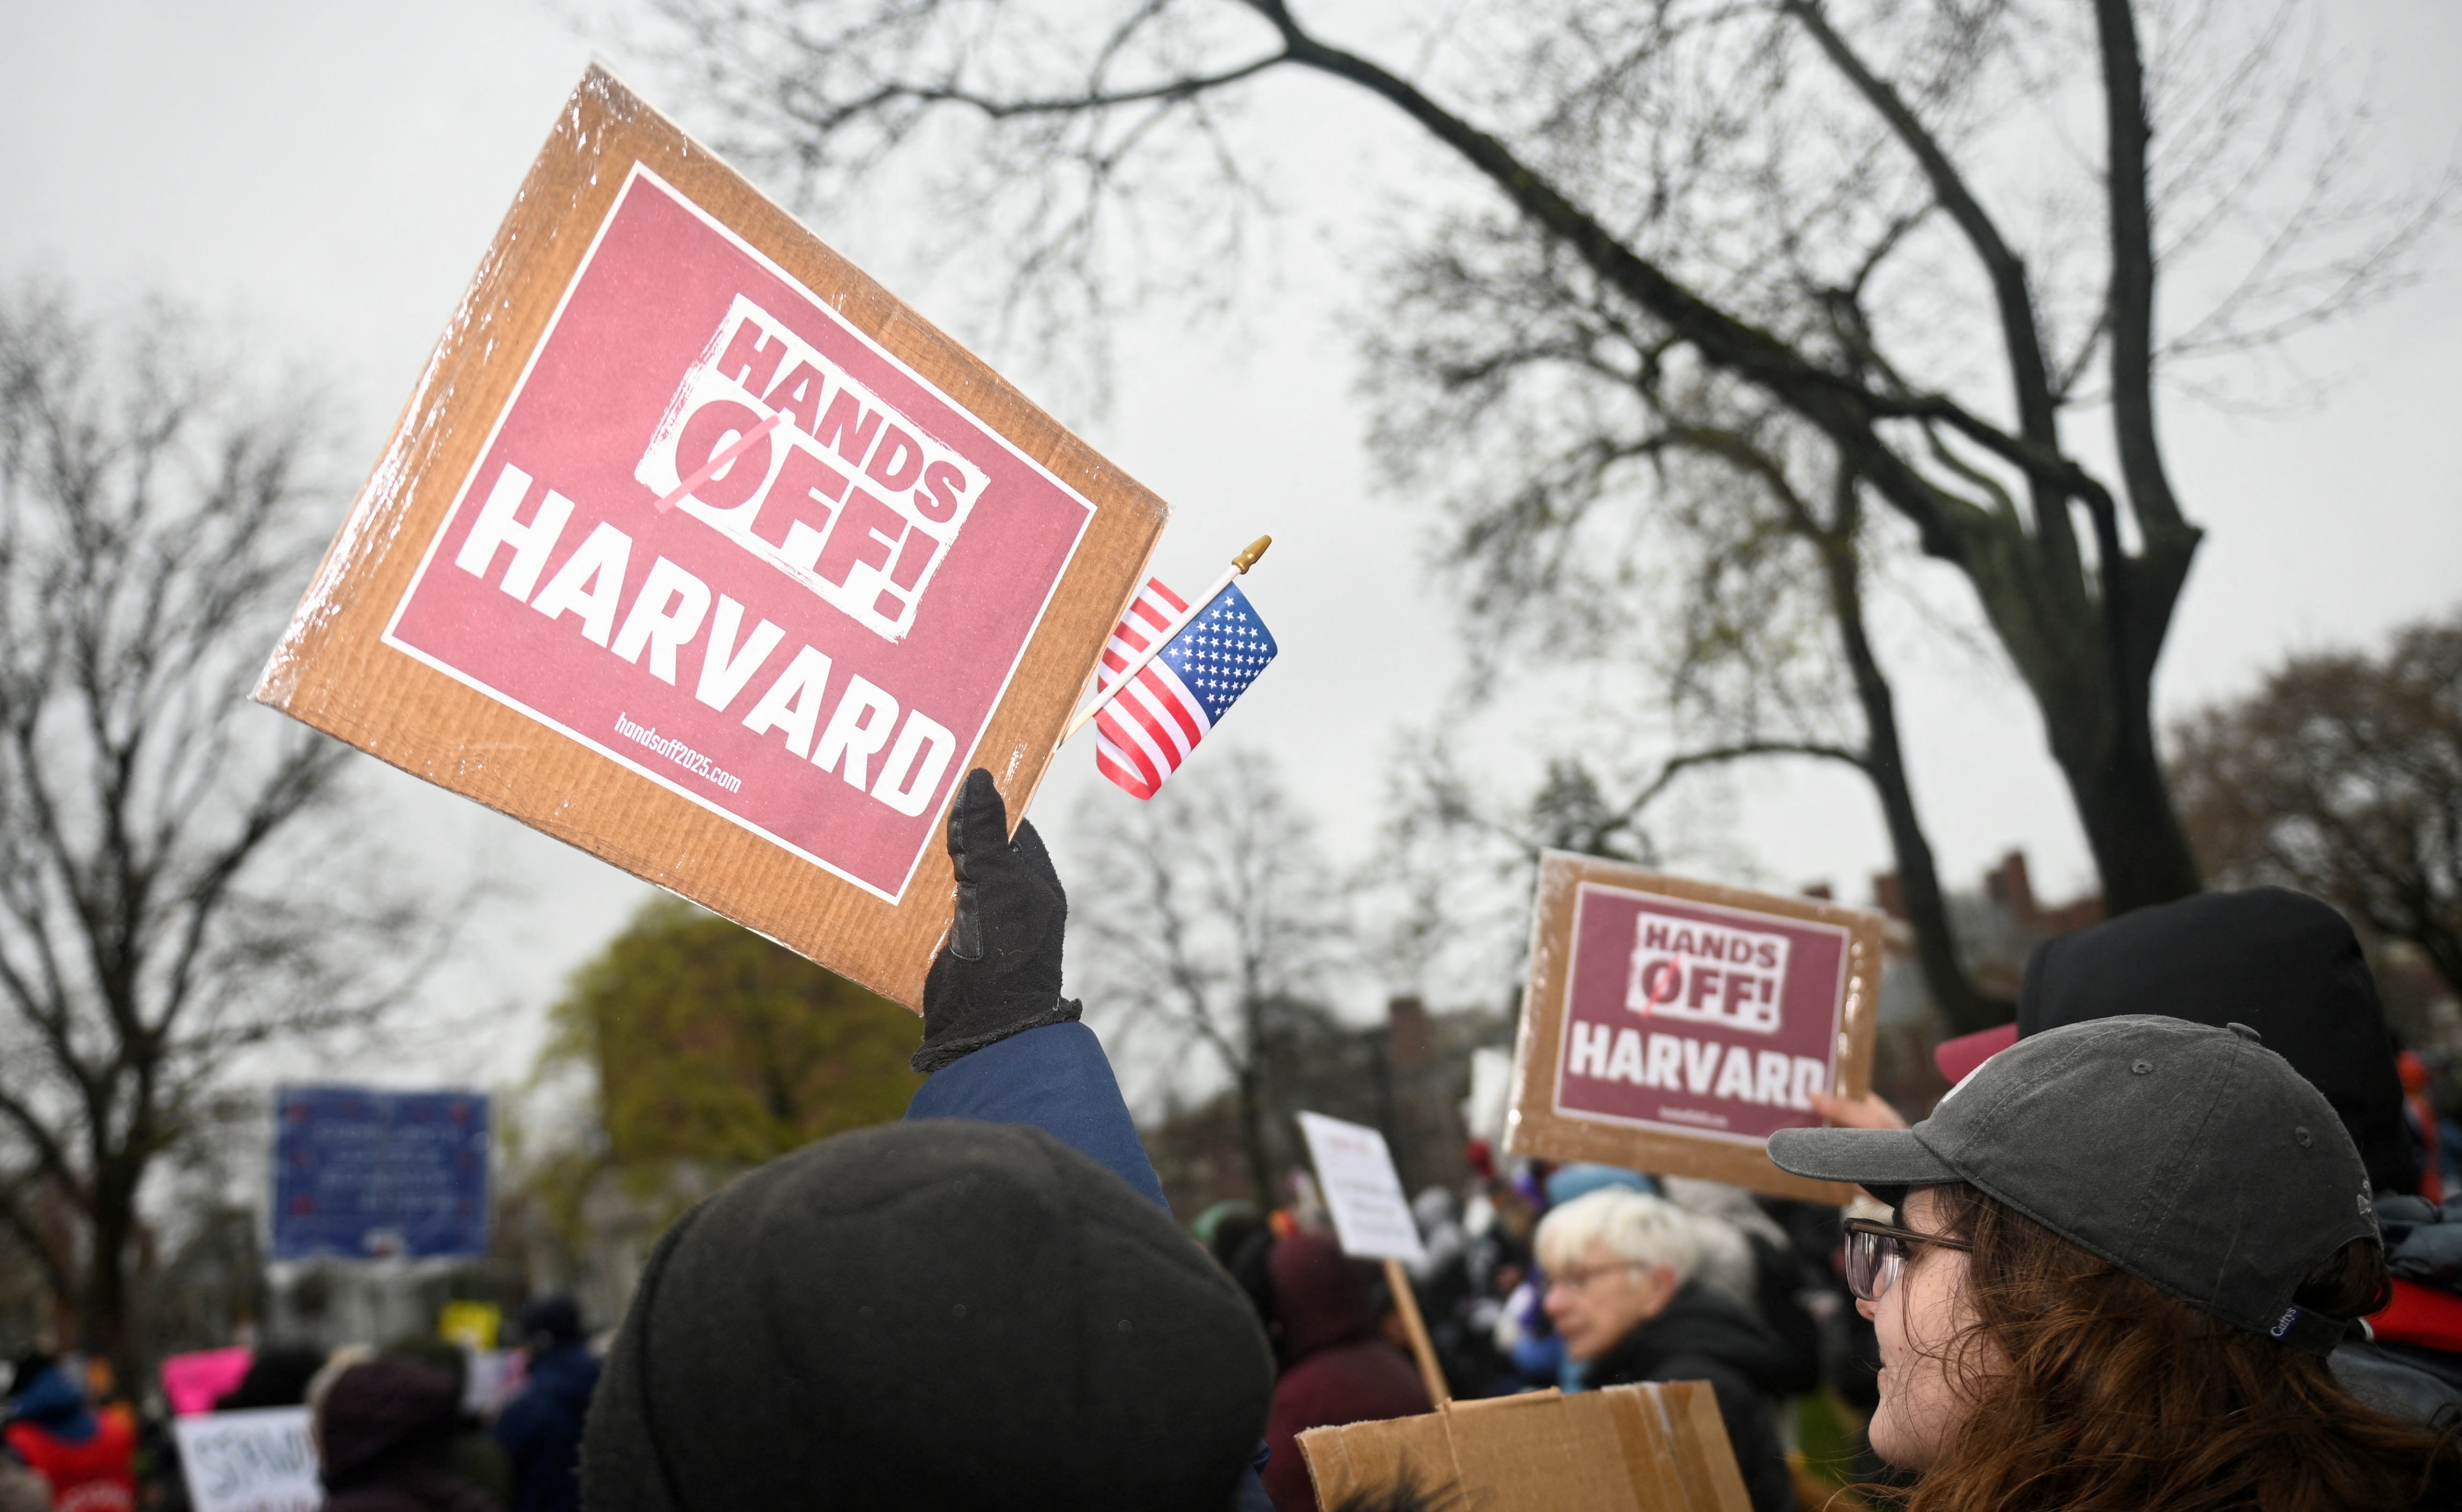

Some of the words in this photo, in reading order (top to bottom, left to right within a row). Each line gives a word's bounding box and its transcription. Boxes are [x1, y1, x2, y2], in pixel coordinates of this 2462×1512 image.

[717, 317, 966, 523] HANDS
[675, 400, 940, 623] OFF!
[455, 463, 956, 817] HARVARD
[614, 712, 742, 793] handsoff2025.com
[1643, 921, 1777, 968] HANDS
[1641, 960, 1775, 1021] OFF!
[1569, 1021, 1827, 1111] HARVARD
